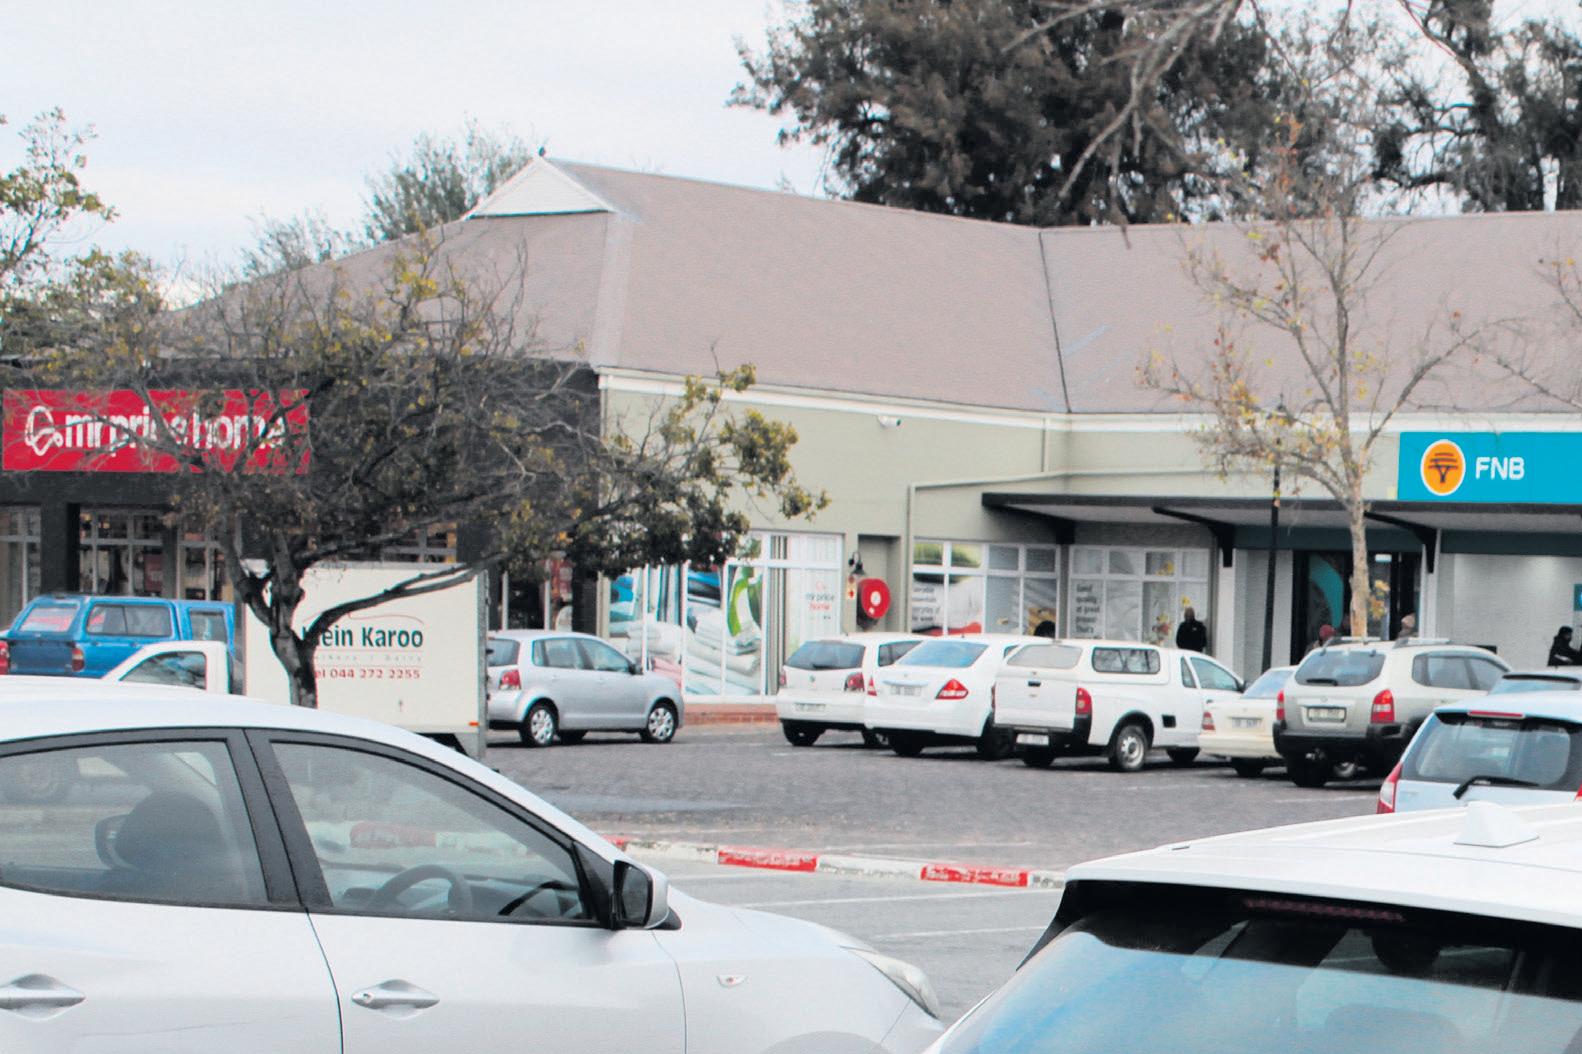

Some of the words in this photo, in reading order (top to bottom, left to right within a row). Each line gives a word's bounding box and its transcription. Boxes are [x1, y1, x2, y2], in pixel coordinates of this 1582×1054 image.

[1475, 456, 1525, 481] FNB
[362, 626, 424, 648] Karoo
[330, 668, 355, 679] 044
[359, 668, 384, 679] 272
[389, 668, 421, 679] 2255
